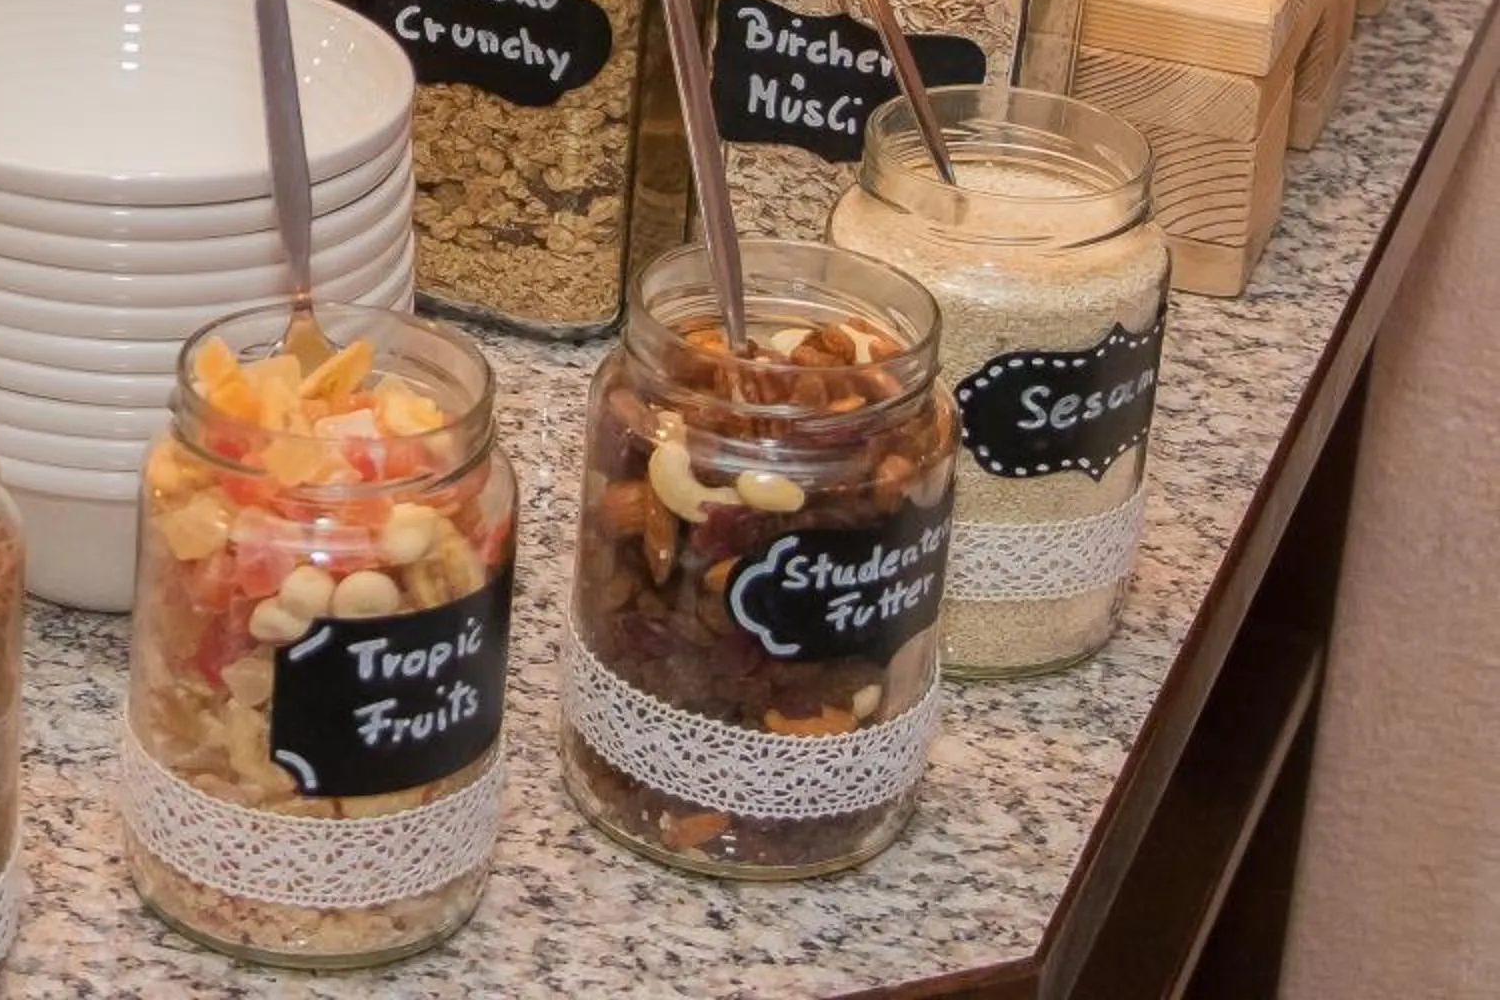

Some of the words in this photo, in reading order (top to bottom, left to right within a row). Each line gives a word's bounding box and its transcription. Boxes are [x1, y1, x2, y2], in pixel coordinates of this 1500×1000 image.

[395, 5, 571, 81] Crunchy
[737, 7, 896, 77] Bircher
[748, 73, 863, 135] Müsli
[825, 572, 934, 632] Futter
[347, 616, 482, 680] Tropic
[353, 680, 479, 745] Fruits
